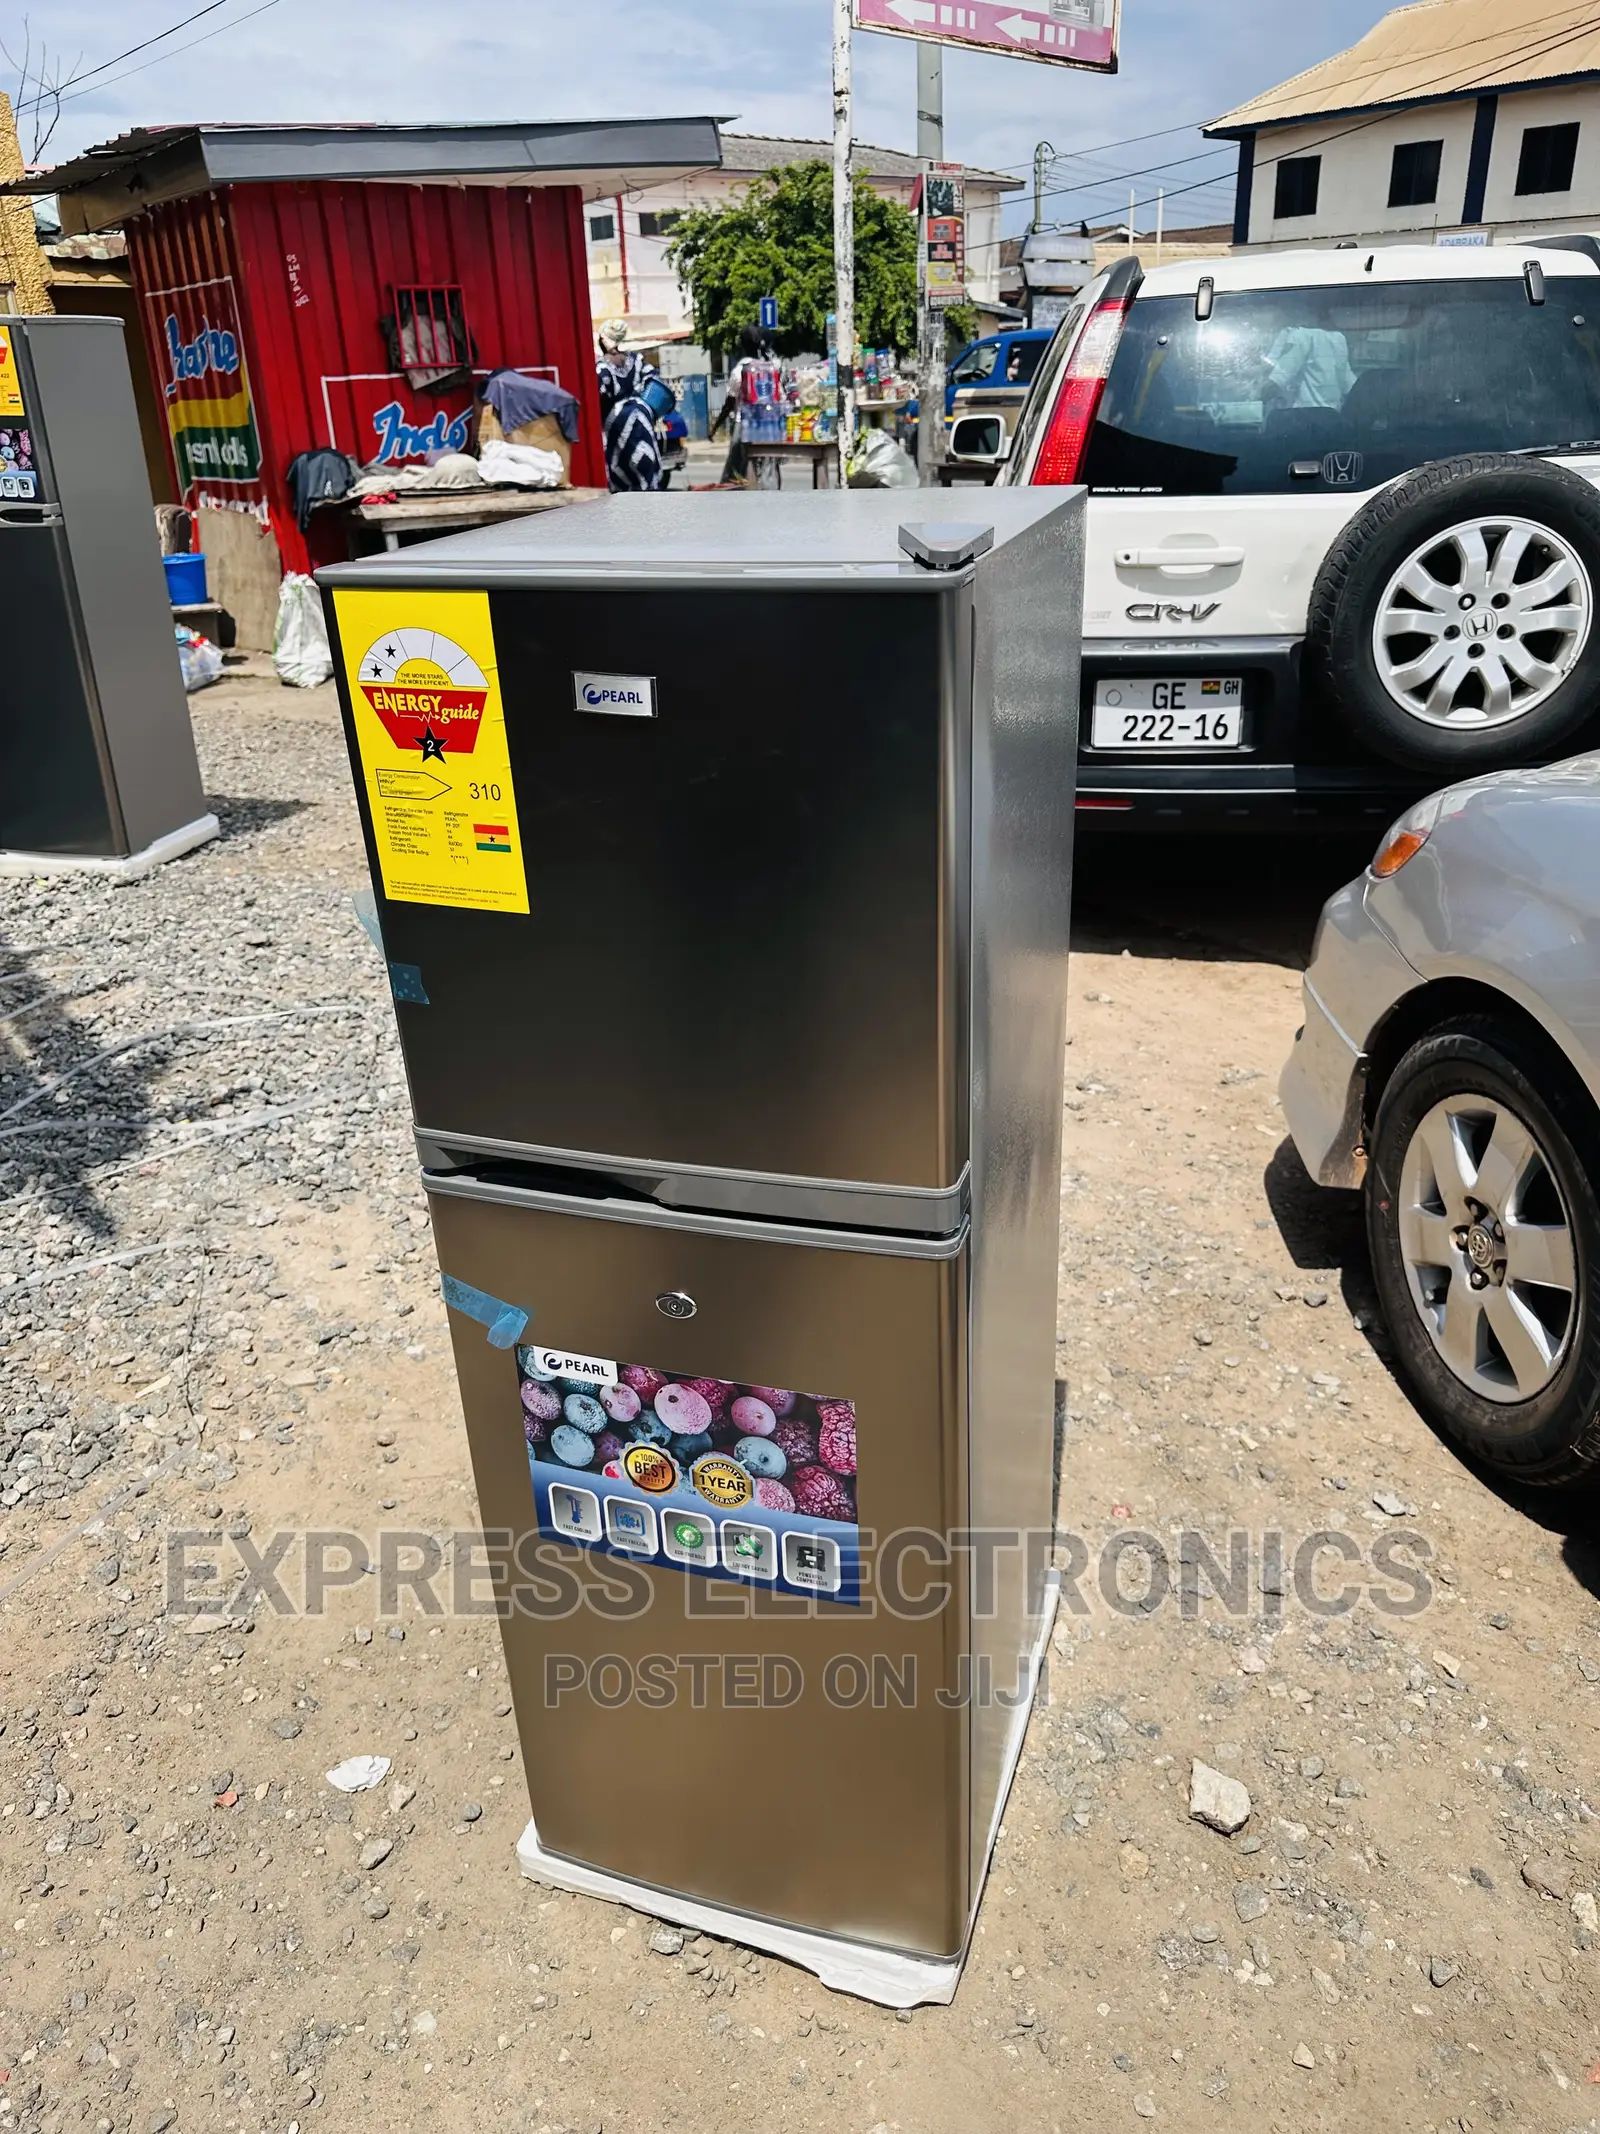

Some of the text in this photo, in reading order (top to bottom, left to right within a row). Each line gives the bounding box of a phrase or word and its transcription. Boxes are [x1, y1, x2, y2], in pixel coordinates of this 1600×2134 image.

[602, 690, 643, 704] PEARL
[1152, 681, 1239, 710] GE GH
[373, 688, 479, 724] ENERGY guide
[1123, 714, 1228, 741] 222-16
[427, 740, 435, 752] 2
[469, 782, 501, 800] 310
[565, 1359, 609, 1377] PEARL
[640, 1453, 658, 1463] 100%
[634, 1460, 666, 1478] BEST
[703, 1462, 742, 1479] WARRANTY
[704, 1488, 742, 1504] WARRANTY
